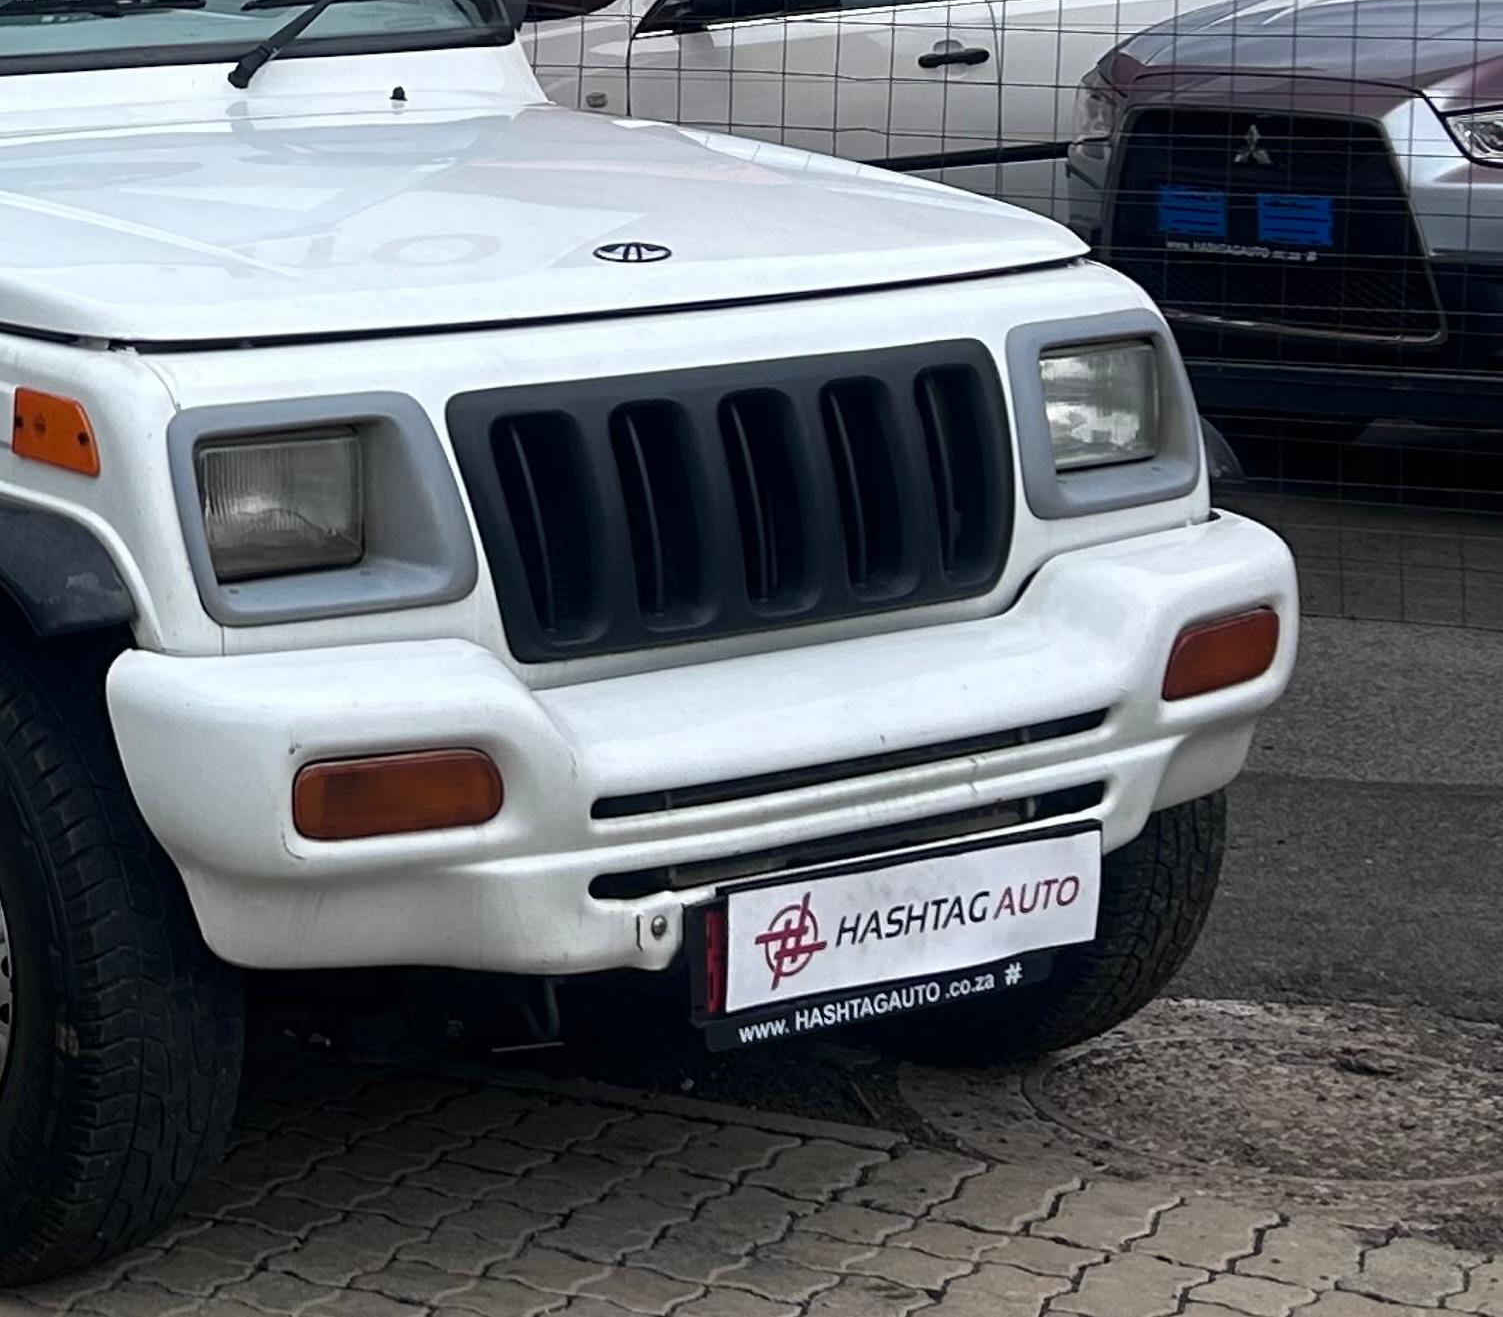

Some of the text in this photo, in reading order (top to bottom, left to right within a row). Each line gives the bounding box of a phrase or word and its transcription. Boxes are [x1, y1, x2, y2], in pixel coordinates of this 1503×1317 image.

[835, 875, 1080, 948] HASHTAG AUTO
[738, 1018, 790, 1044] www.
[795, 981, 941, 1031] HASHTAGAUTO
